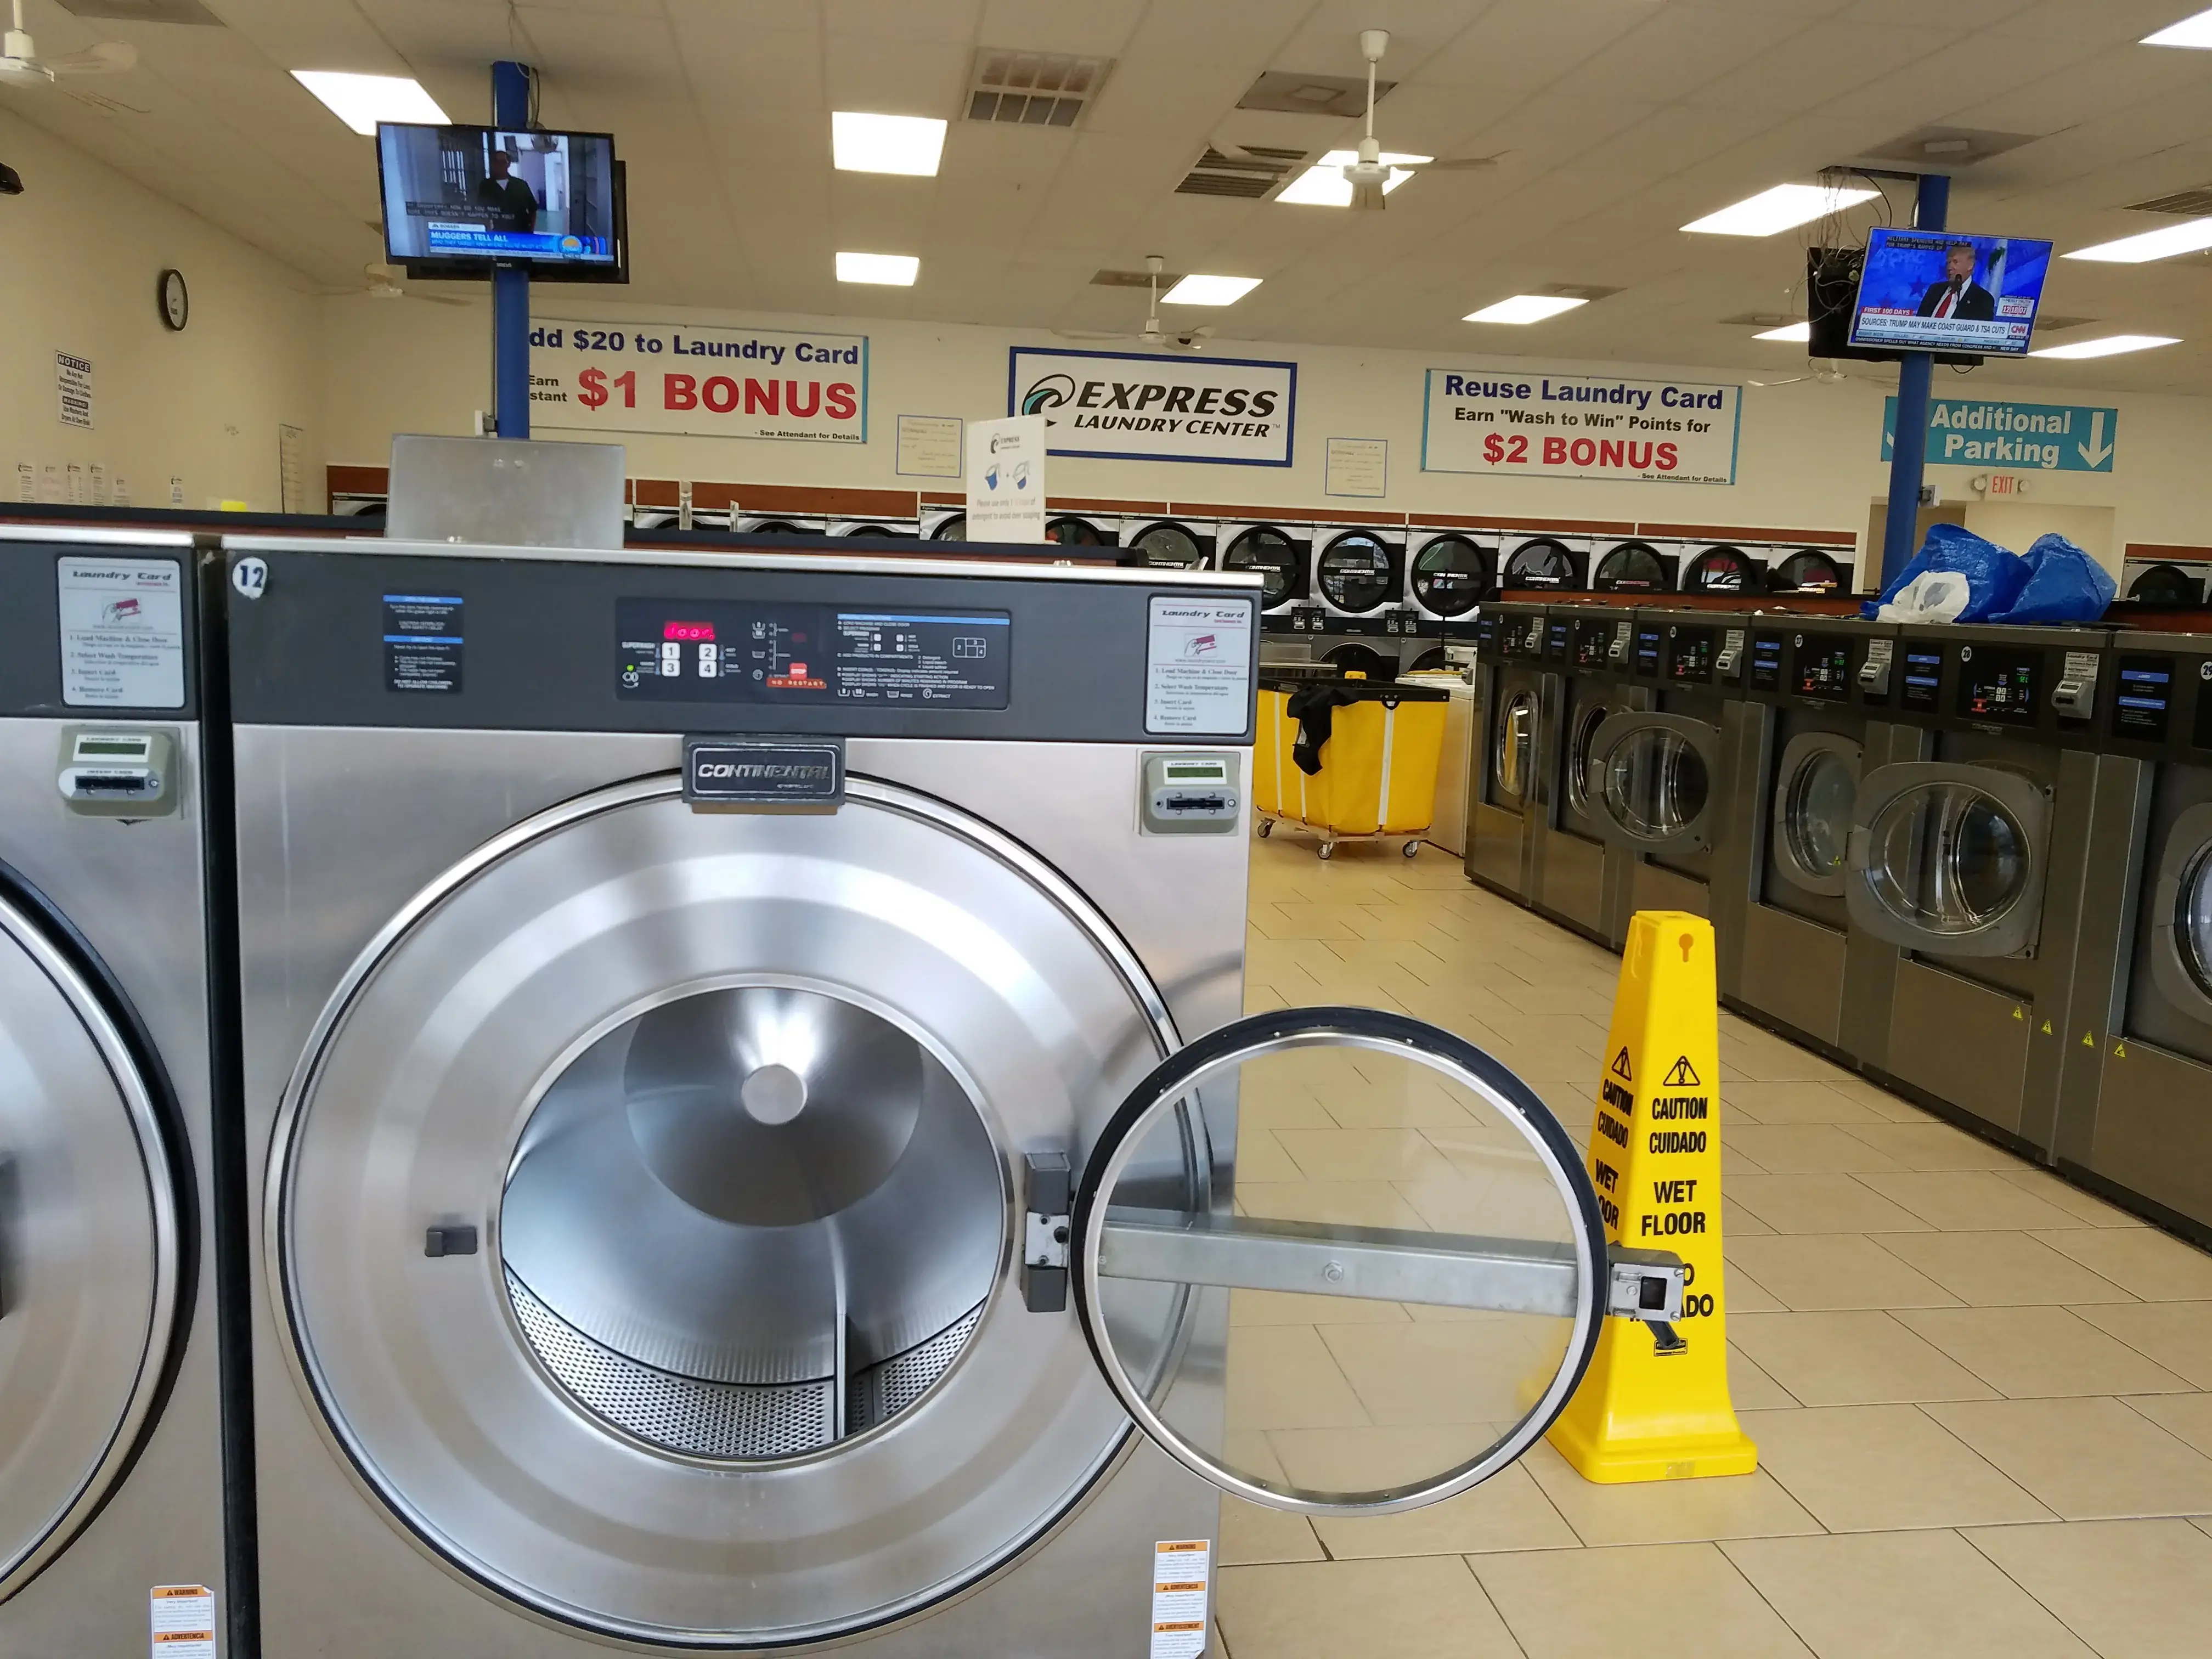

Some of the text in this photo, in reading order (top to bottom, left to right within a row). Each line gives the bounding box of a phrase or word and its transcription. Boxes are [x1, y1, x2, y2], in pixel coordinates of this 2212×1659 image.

[431, 232, 471, 240] MUGGERS
[1861, 317, 1888, 326] SOURCES:
[1889, 319, 1908, 328] TRUMP
[1909, 320, 1921, 329] MAY
[1921, 321, 1937, 330] MAKE
[1938, 322, 1956, 331] COAST
[1956, 324, 1974, 332] GUARD
[1981, 325, 1990, 334] TSA
[1991, 326, 2006, 335] CUTS
[2011, 325, 2027, 334] CNN
[529, 328, 858, 366] dd $20 to Laundry Card
[58, 355, 90, 373] NOTICE
[529, 391, 567, 402] stant
[578, 366, 857, 420] $1 BONUS
[1076, 380, 1279, 418] EXPRESS
[1444, 374, 1724, 410] Reuse Laundry Card
[1074, 414, 1270, 438] LAUNDRY CENTER
[1454, 408, 1711, 433] Earn "Wash to Win" Points for
[1930, 403, 2072, 434] Additional
[776, 431, 816, 439] Attendant
[832, 433, 860, 441] Details
[1482, 432, 1679, 470] $2 BONUS
[1944, 433, 2060, 469] Parking
[1656, 473, 1690, 482] Attendant
[1703, 476, 1728, 484] Details
[1991, 476, 2015, 494] EXIT
[73, 571, 172, 581] Laundry Card
[239, 565, 265, 589] 12
[1162, 610, 1211, 618] Laundry
[668, 647, 712, 657] 1 2
[1962, 649, 1971, 658] 28
[667, 663, 712, 674] 3 4
[697, 764, 830, 780] CONTINENTAL
[1602, 1078, 1634, 1117] CAUTION
[1652, 1097, 1708, 1120] CAUTION
[1597, 1110, 1629, 1149] CUIDADO
[1649, 1131, 1707, 1154] CUIDADO
[1595, 1158, 1619, 1194] WET
[1654, 1180, 1697, 1204] WET
[1598, 1194, 1619, 1231] OOR
[1641, 1211, 1706, 1237] FLOOR
